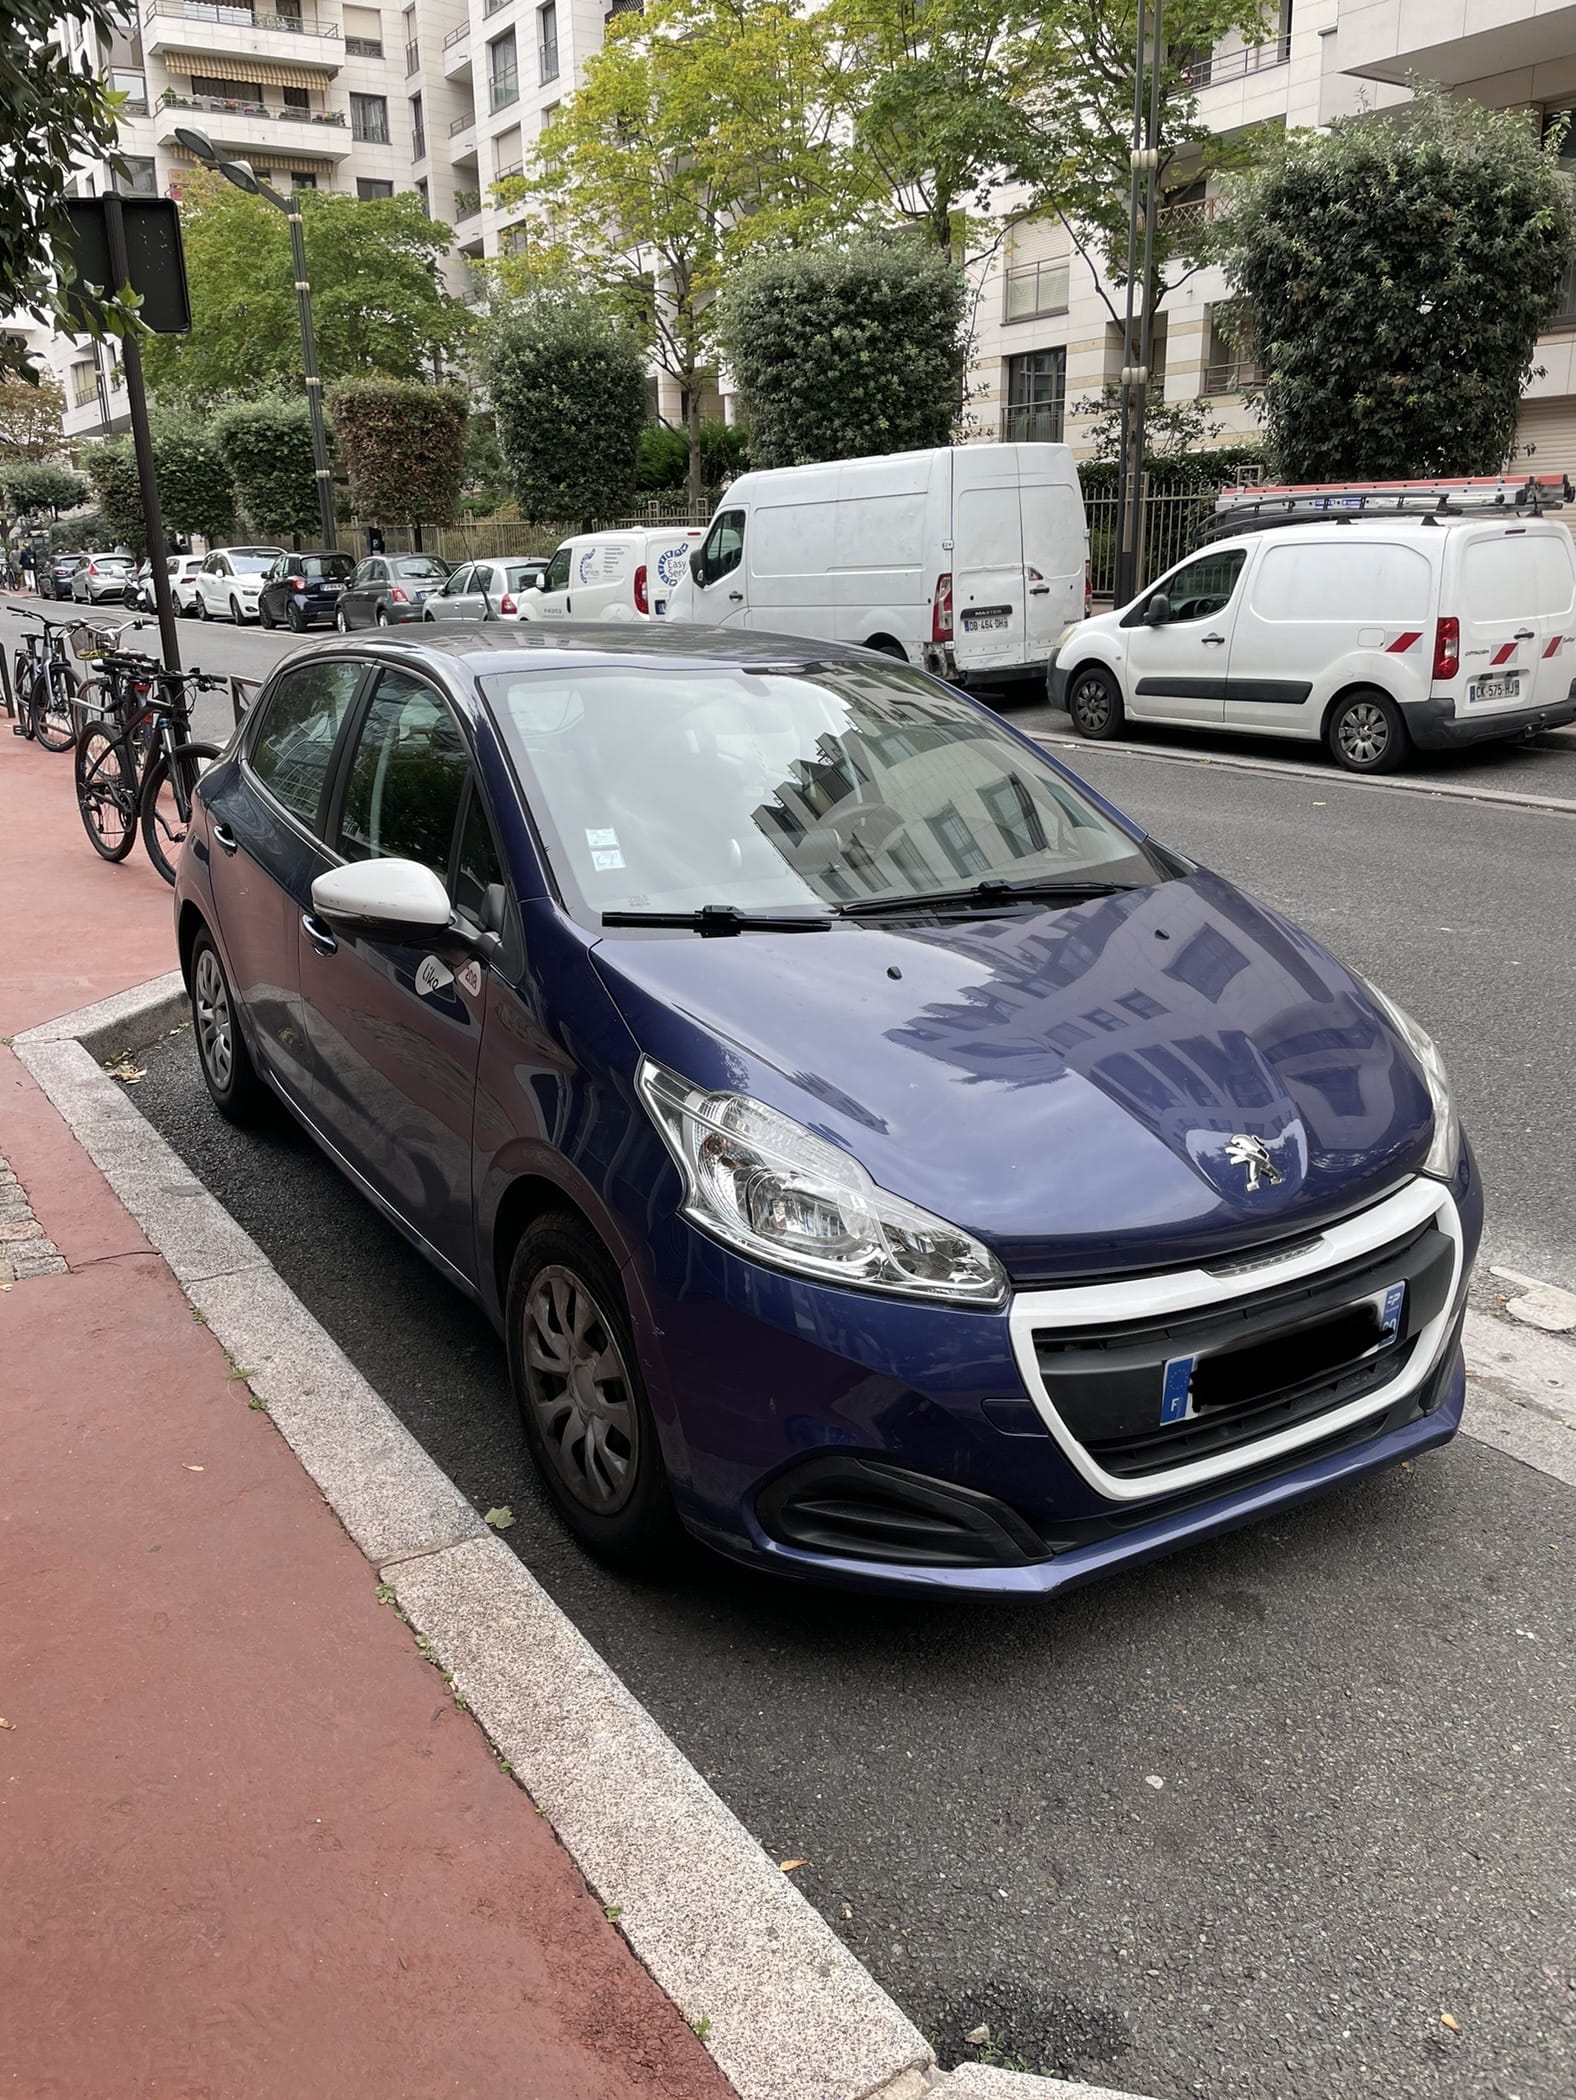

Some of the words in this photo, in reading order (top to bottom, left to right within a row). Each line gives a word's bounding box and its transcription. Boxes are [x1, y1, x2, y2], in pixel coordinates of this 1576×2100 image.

[667, 559, 687, 569] Easy
[1476, 681, 1515, 699] CK-575-HJ
[1170, 1397, 1180, 1412] F
